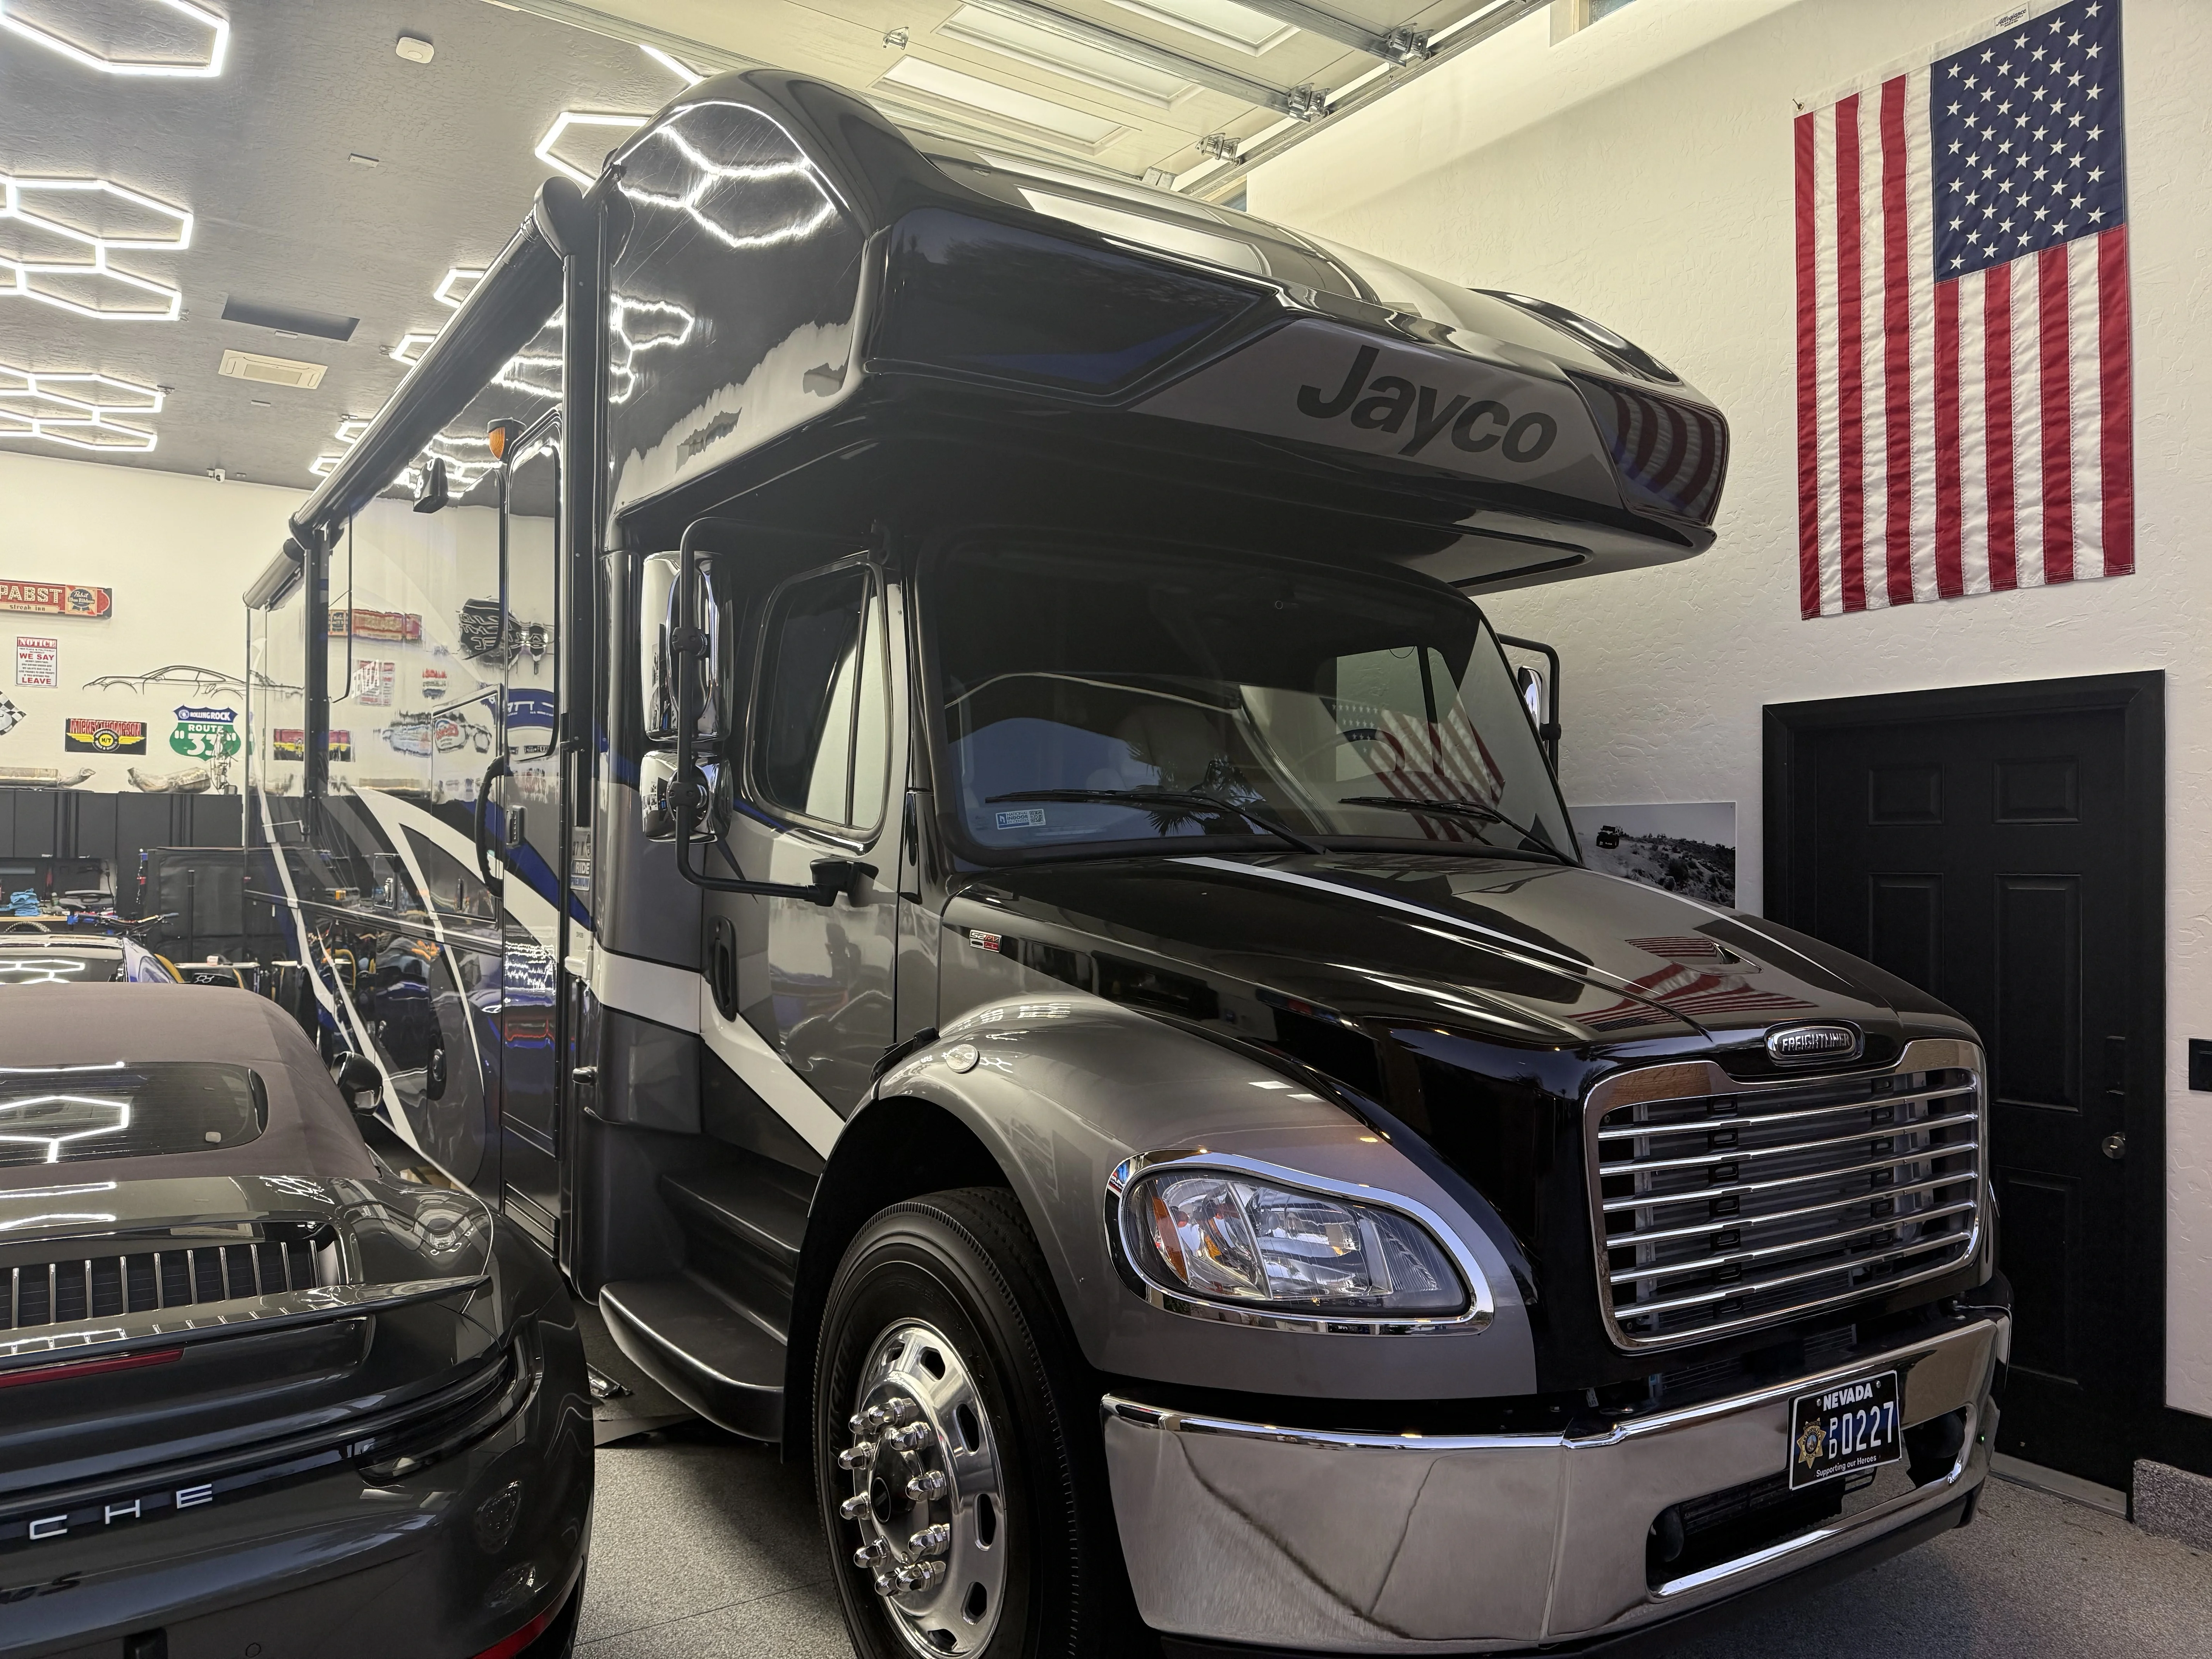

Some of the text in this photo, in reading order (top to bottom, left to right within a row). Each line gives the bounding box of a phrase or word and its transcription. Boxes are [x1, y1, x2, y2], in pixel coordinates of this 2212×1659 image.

[1297, 344, 1558, 463] Jayco
[0, 585, 62, 603] PABST
[19, 639, 55, 647] NOTICE
[210, 712, 232, 721] ROCK
[70, 719, 141, 737] MICKEY THOMPSON
[188, 724, 224, 733] ROUTE
[970, 932, 999, 942] S2RV
[1782, 1033, 1850, 1052] FREIGHTLINER
[1823, 1383, 1873, 1411] NEVADA
[1842, 1401, 1894, 1455] 0227
[1816, 1455, 1877, 1477] Supporting our Heroes
